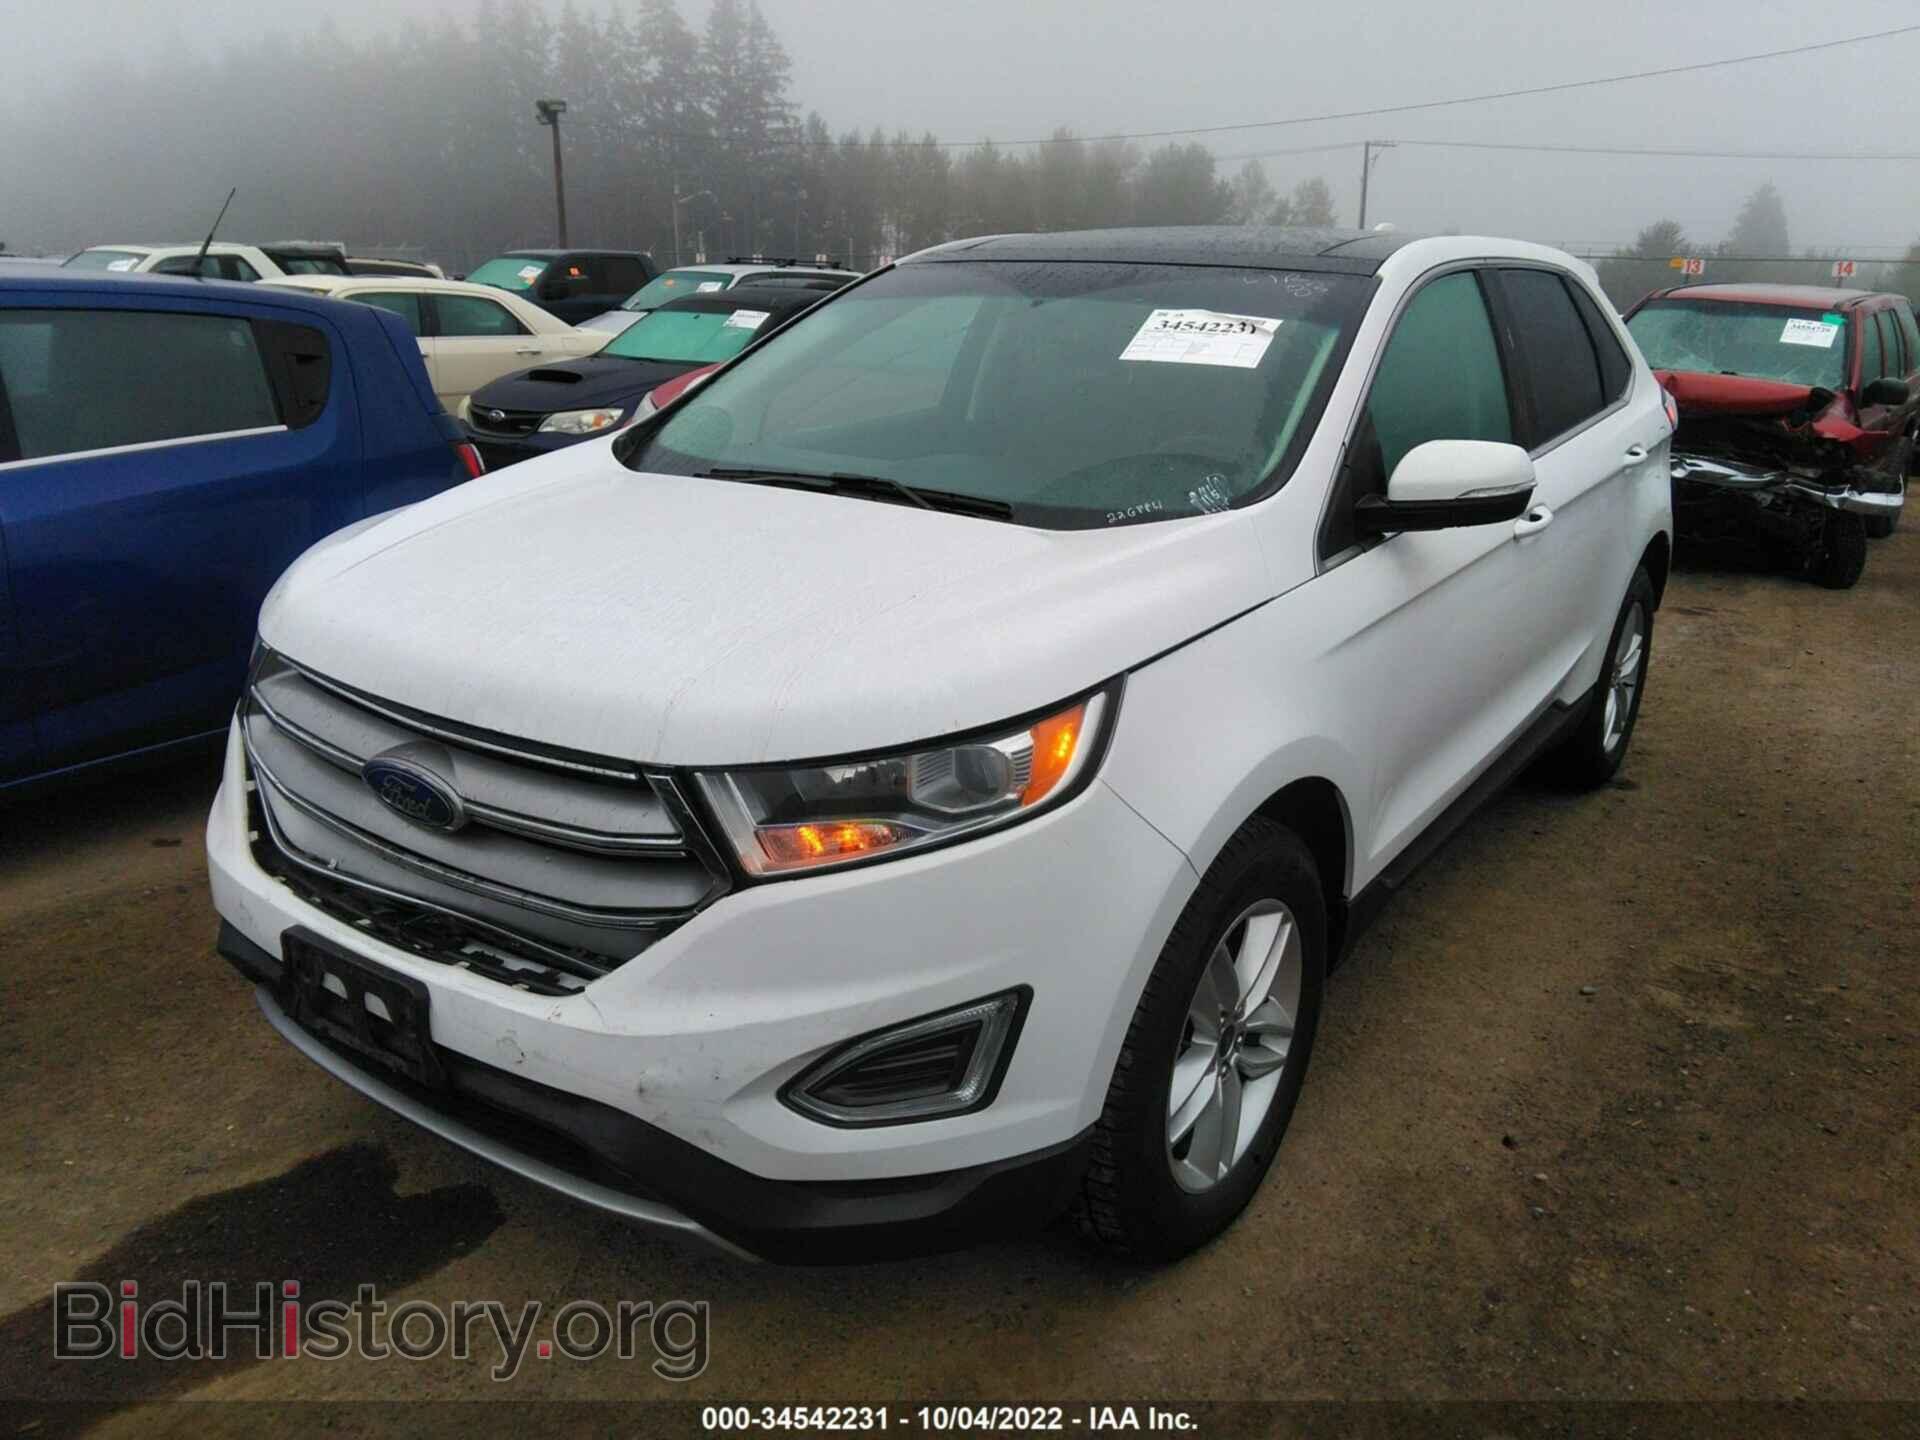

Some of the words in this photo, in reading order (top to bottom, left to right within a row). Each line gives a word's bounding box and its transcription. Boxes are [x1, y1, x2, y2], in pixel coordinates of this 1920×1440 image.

[1685, 260, 1701, 274] 13
[1837, 260, 1853, 274] 14
[1154, 319, 1257, 335] 34542231
